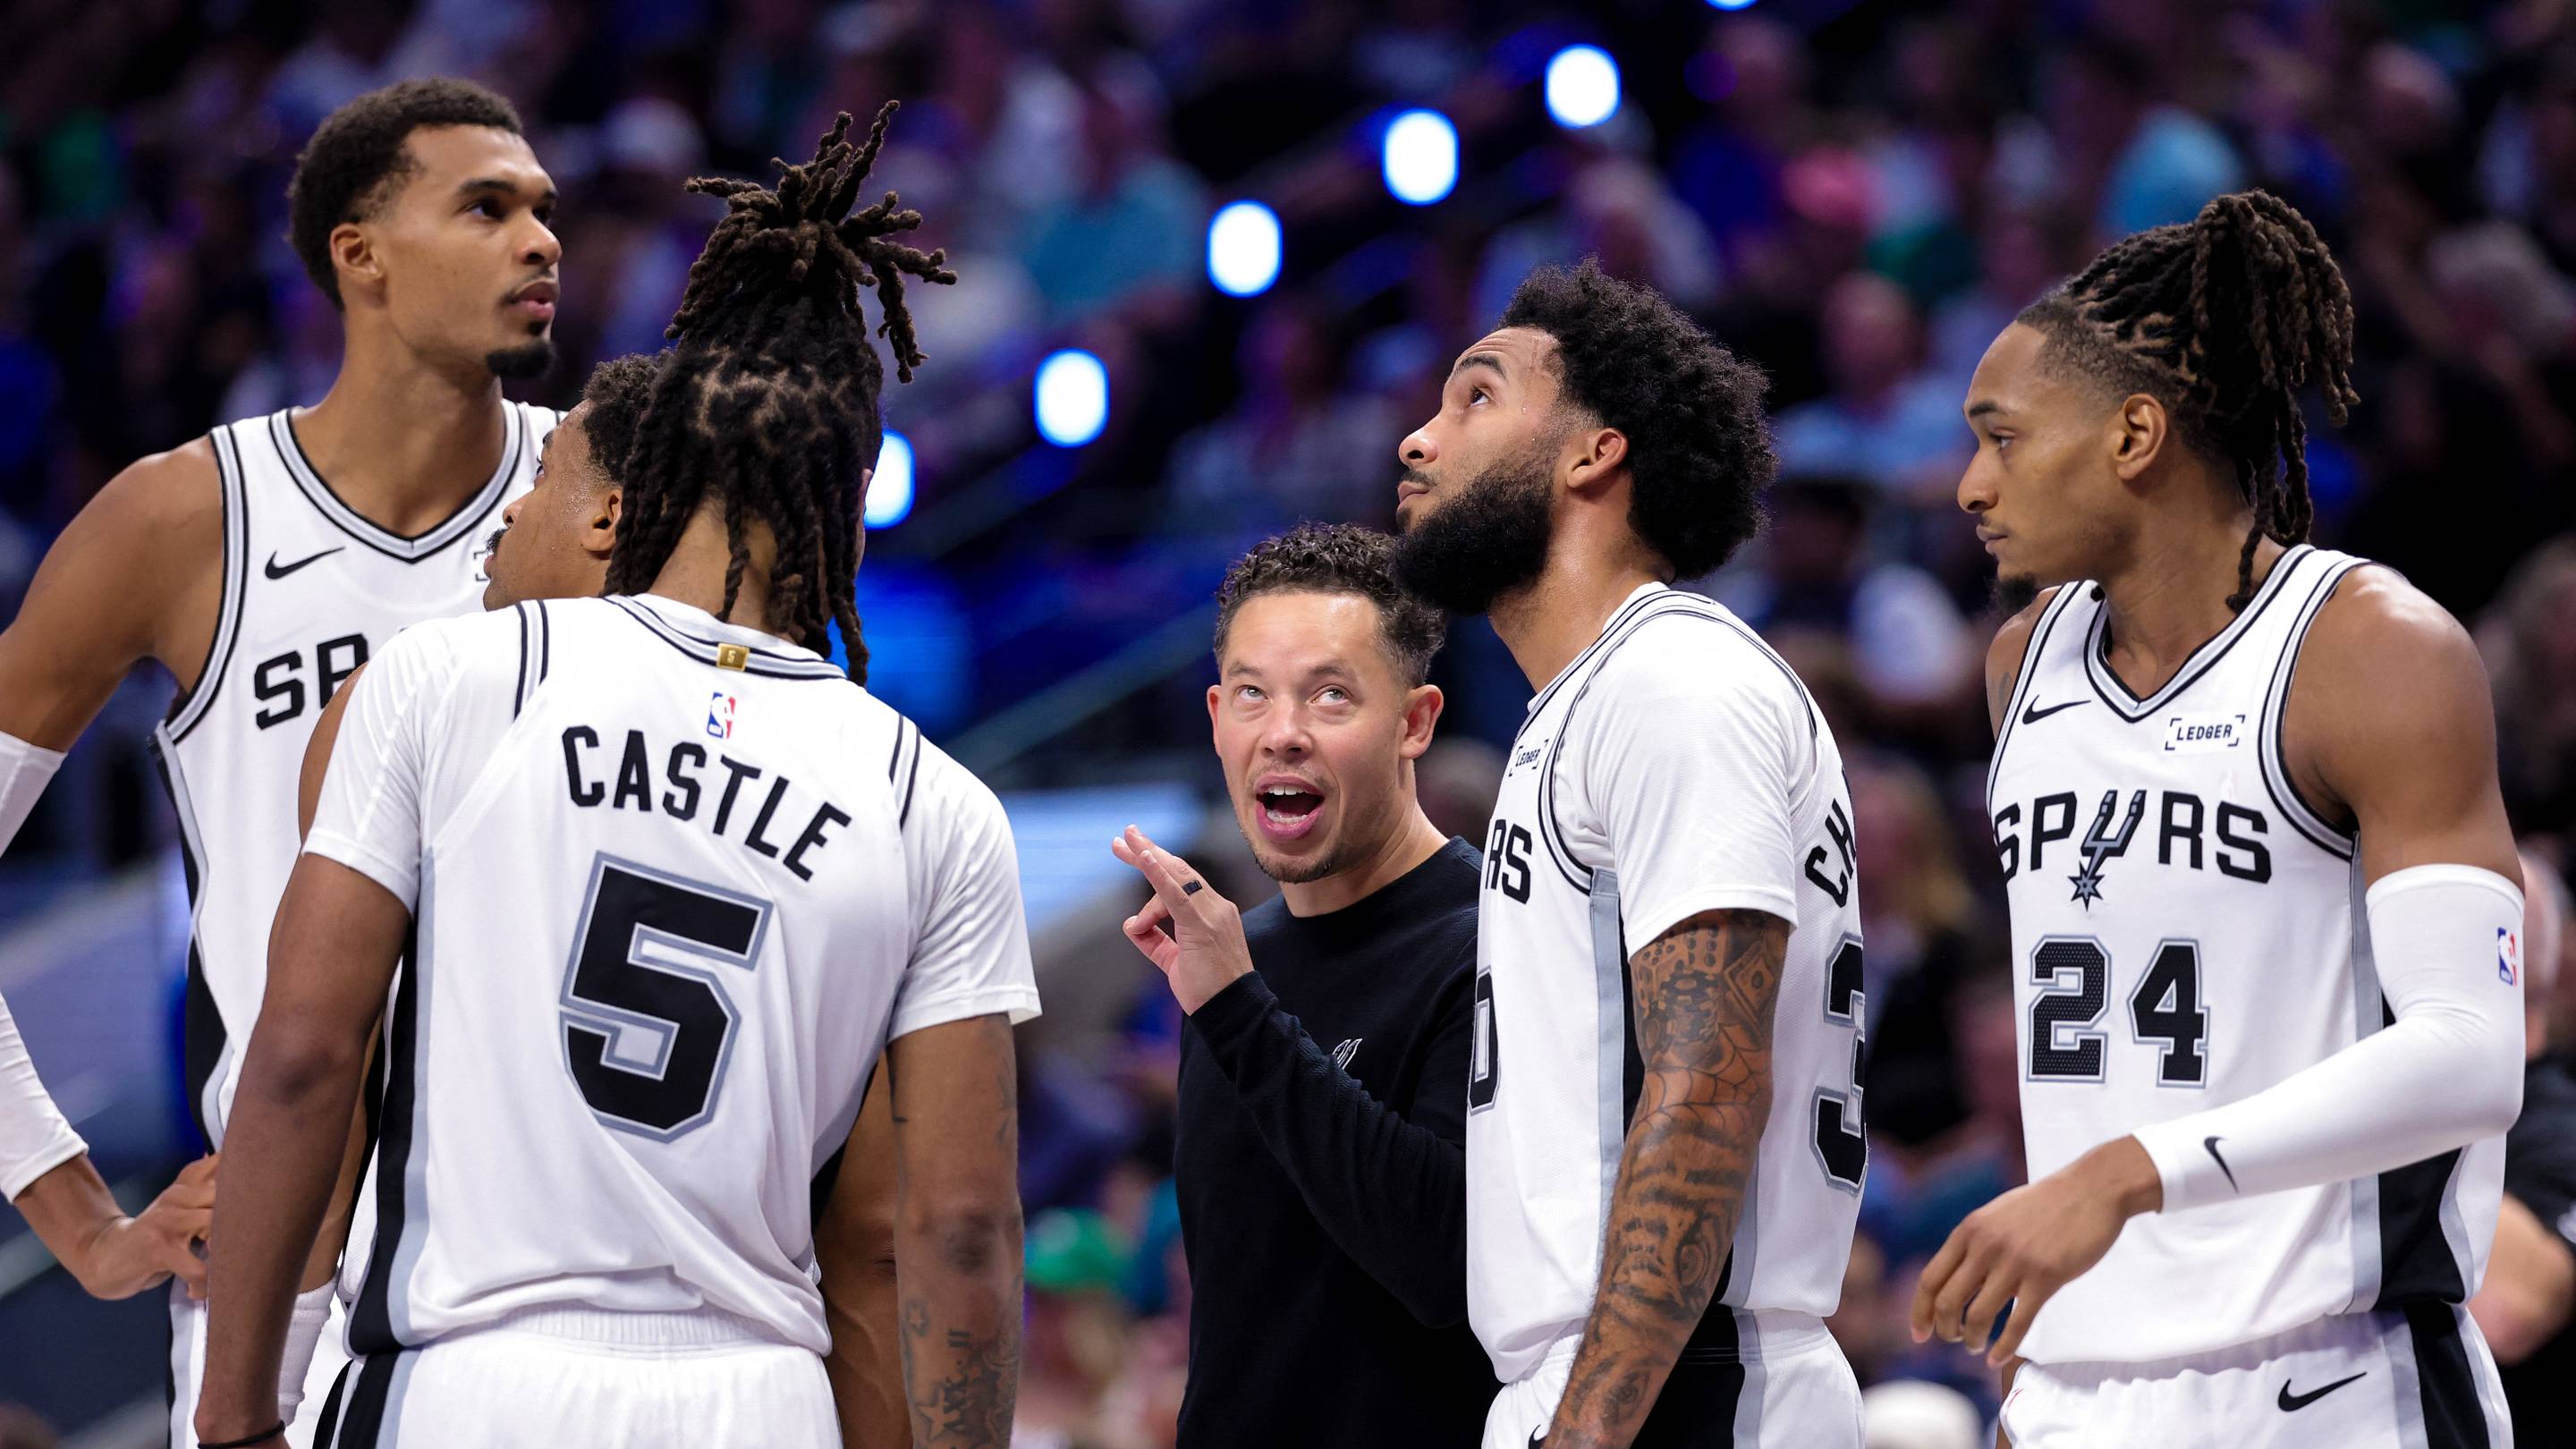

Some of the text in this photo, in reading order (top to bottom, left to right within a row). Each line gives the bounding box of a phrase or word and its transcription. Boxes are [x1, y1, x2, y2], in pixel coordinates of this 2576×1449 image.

[253, 632, 369, 730] SP
[2176, 724, 2233, 741] LEDGER
[562, 725, 852, 882] CASTLE
[1484, 818, 1533, 905] RS
[1804, 798, 1857, 909] CH
[1993, 789, 2272, 912] SPURS
[559, 851, 774, 1144] 5
[2026, 934, 2210, 1089] 24
